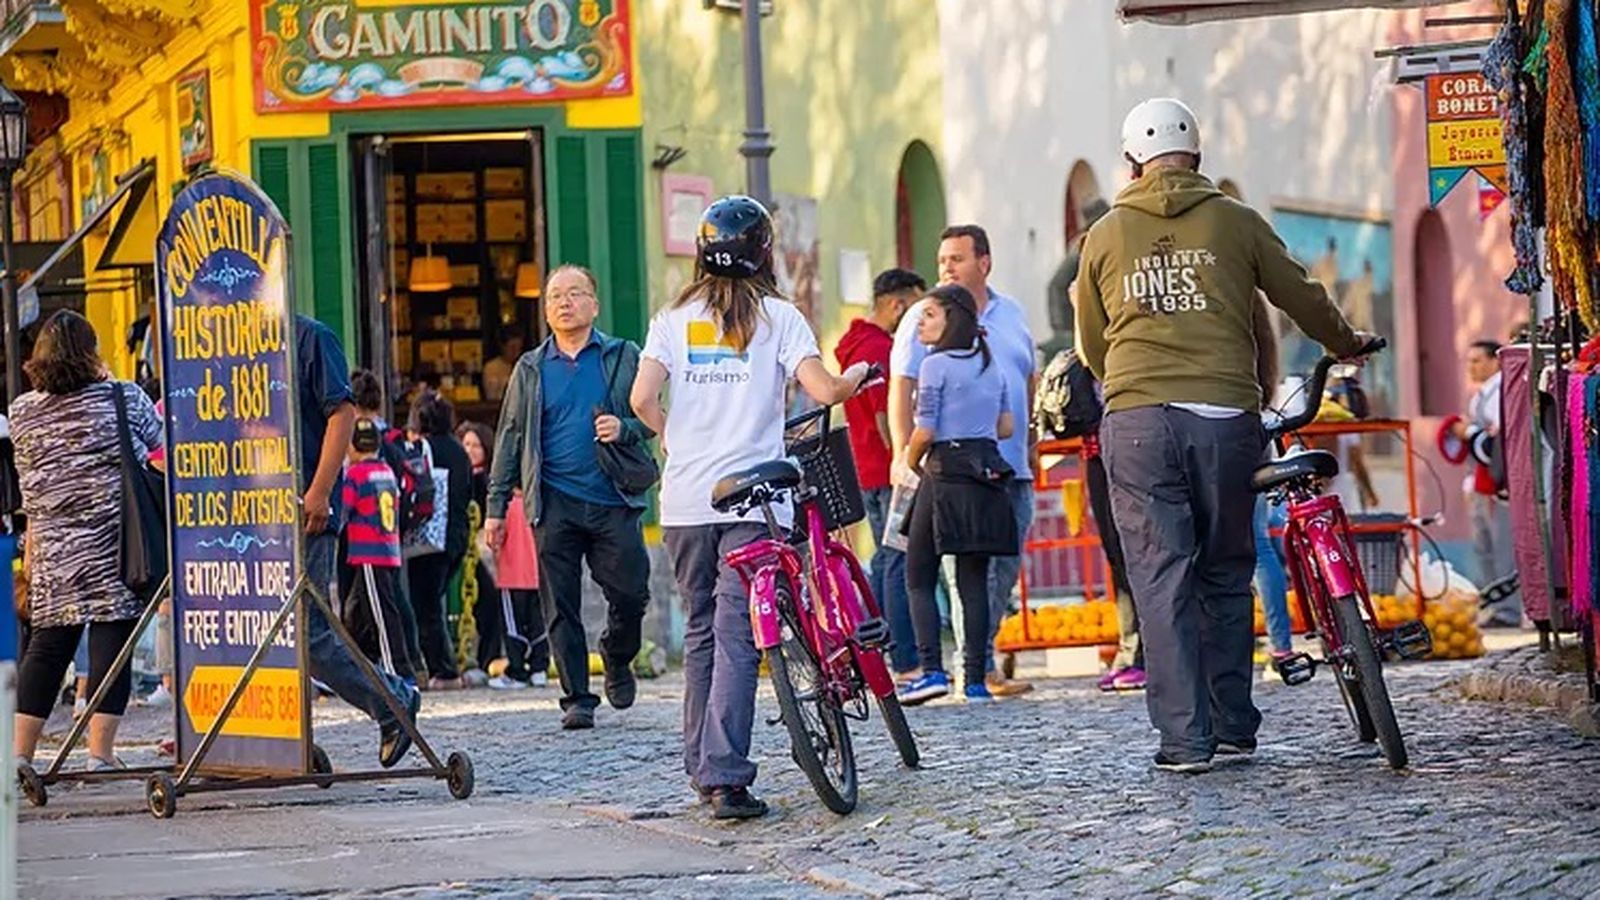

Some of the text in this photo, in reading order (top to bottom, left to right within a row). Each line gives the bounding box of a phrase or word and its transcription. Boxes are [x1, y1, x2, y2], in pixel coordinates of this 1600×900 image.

[310, 0, 572, 60] CAMINITO
[1437, 96, 1498, 114] BONET
[714, 251, 733, 267] 13
[1133, 252, 1201, 271] INDIANA
[1123, 267, 1198, 303] JONES
[1147, 293, 1207, 312] 1935
[173, 300, 281, 361] HISTORICO
[197, 362, 271, 422] de 1881
[683, 370, 750, 384] Turismo
[174, 436, 293, 478] CENTRO CULTURAL
[175, 488, 296, 527] DE LOS ARTISTAS
[184, 560, 291, 602] ENTRADA LIBRE
[184, 610, 220, 650] FREE
[190, 682, 274, 721] MAGAANES
